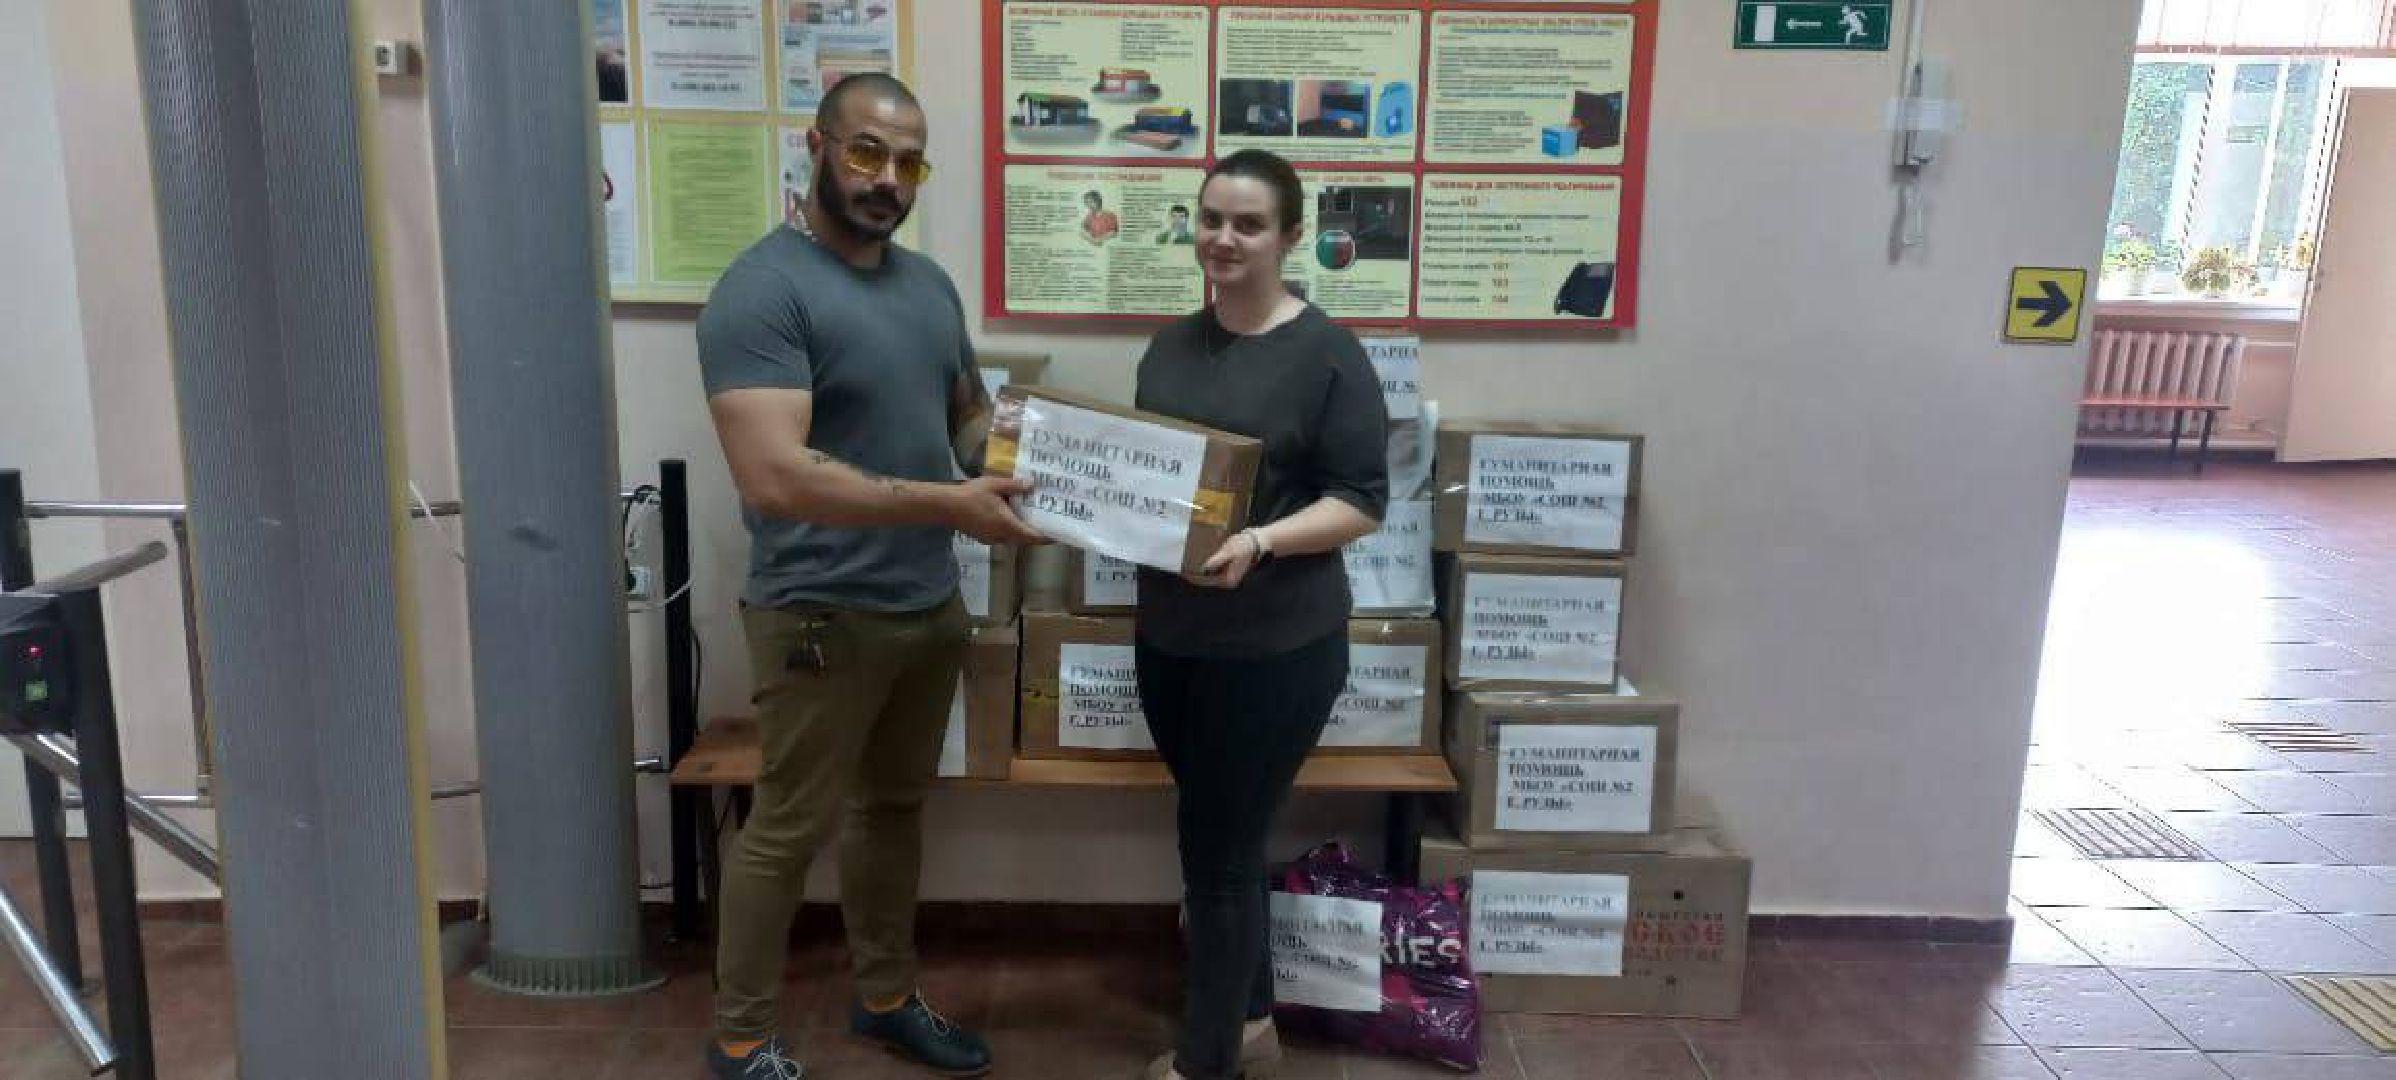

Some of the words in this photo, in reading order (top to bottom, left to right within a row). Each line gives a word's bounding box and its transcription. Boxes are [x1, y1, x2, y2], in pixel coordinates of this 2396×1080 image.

[1032, 427, 1183, 475] ГУМАНИТАРНАЯ
[1030, 448, 1112, 481] ПОМОЩЬ
[1480, 459, 1612, 476] ГУМАНИТАРНАЯ
[1480, 475, 1555, 490] ПОМОЩЬ
[1474, 597, 1605, 611] ГУМАНИТАРНАЯ
[1474, 613, 1549, 627] ПОМОЩЬ
[1070, 665, 1138, 681] ГУМАНИ
[1509, 747, 1640, 762] ГУМАНИТАРНАЯ
[1508, 764, 1584, 778] ПОМОЩЬ
[1480, 895, 1612, 910] ГУМАНИТАРНАЯ
[1480, 911, 1555, 923] ПОМОЩЬ
